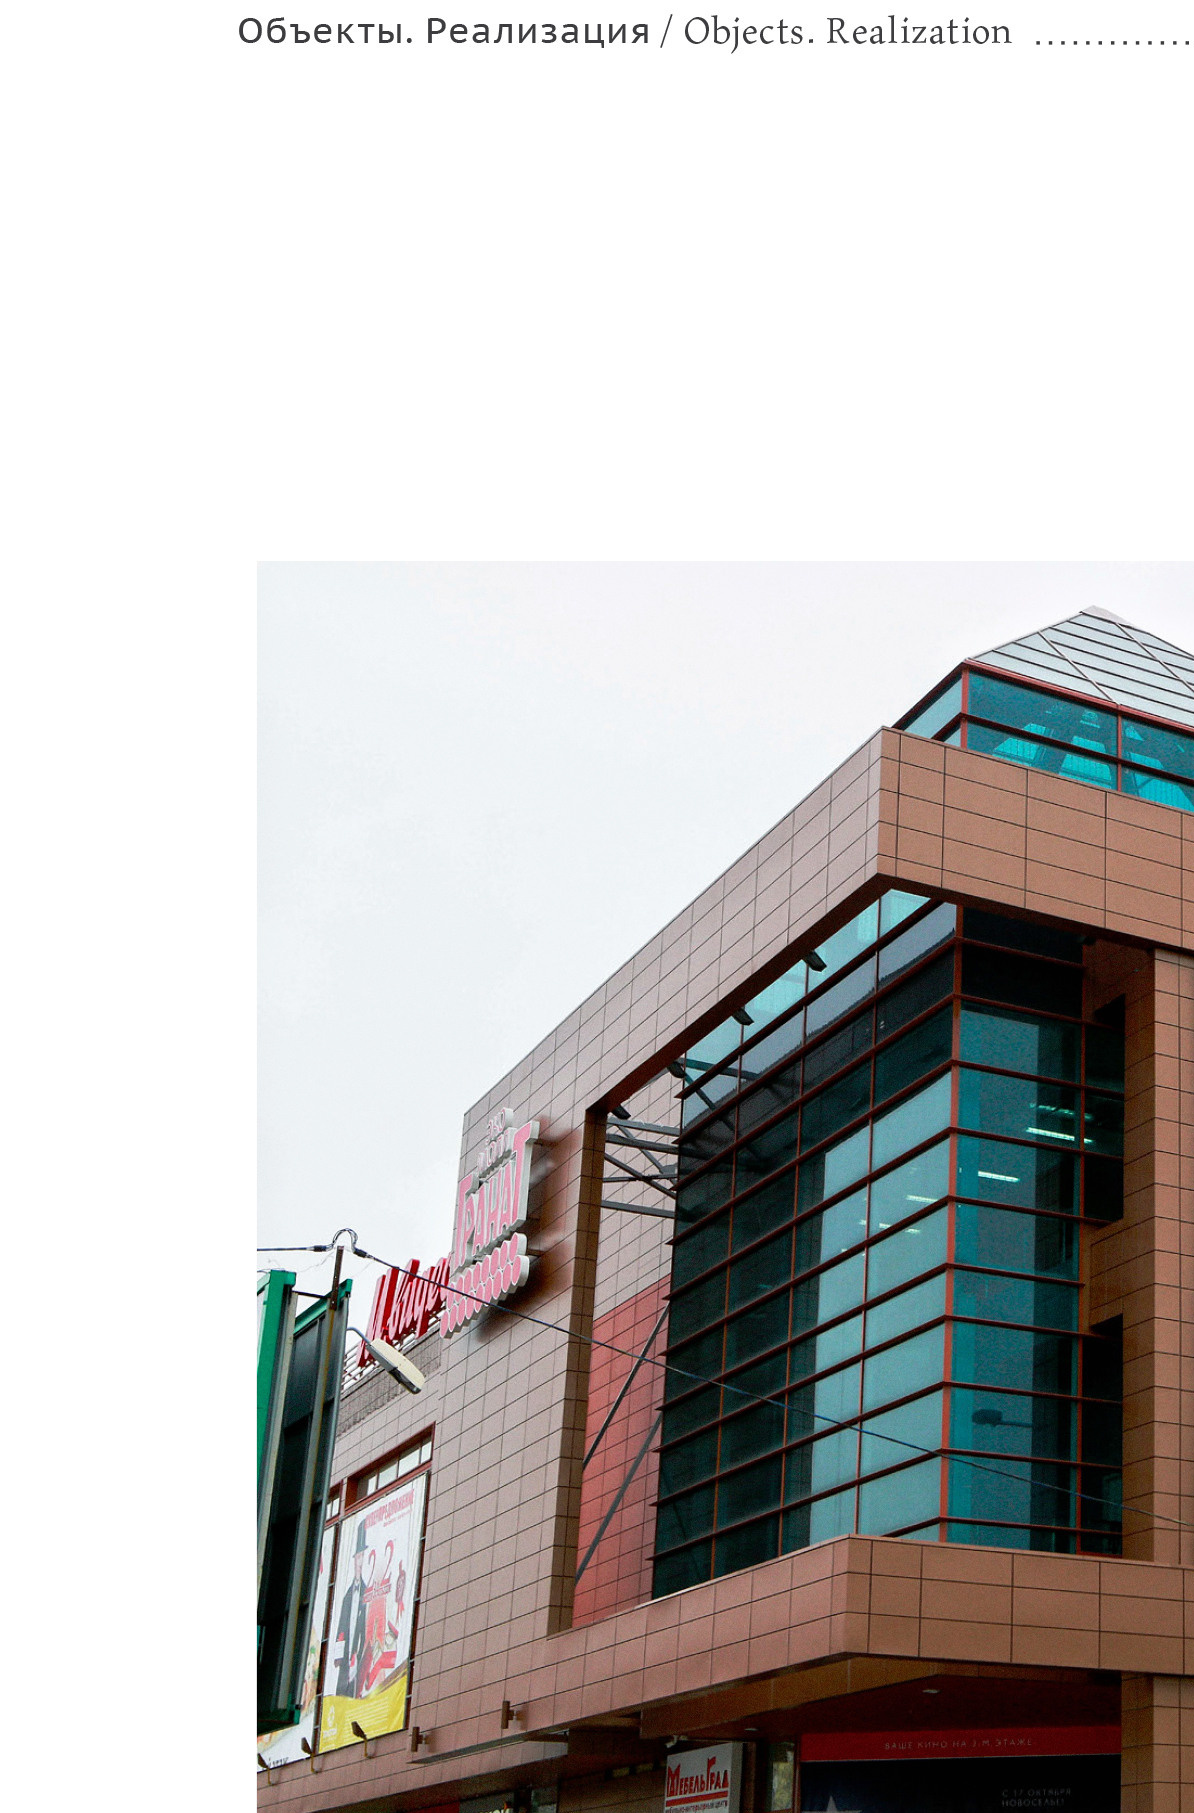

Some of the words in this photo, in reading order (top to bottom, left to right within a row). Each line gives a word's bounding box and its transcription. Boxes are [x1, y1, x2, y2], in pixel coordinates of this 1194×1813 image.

[452, 1120, 540, 1271] ГРАНАТ
[884, 1741, 914, 1751] ВАШЕ
[917, 1740, 948, 1749] КИНО
[952, 1739, 967, 1748] НА
